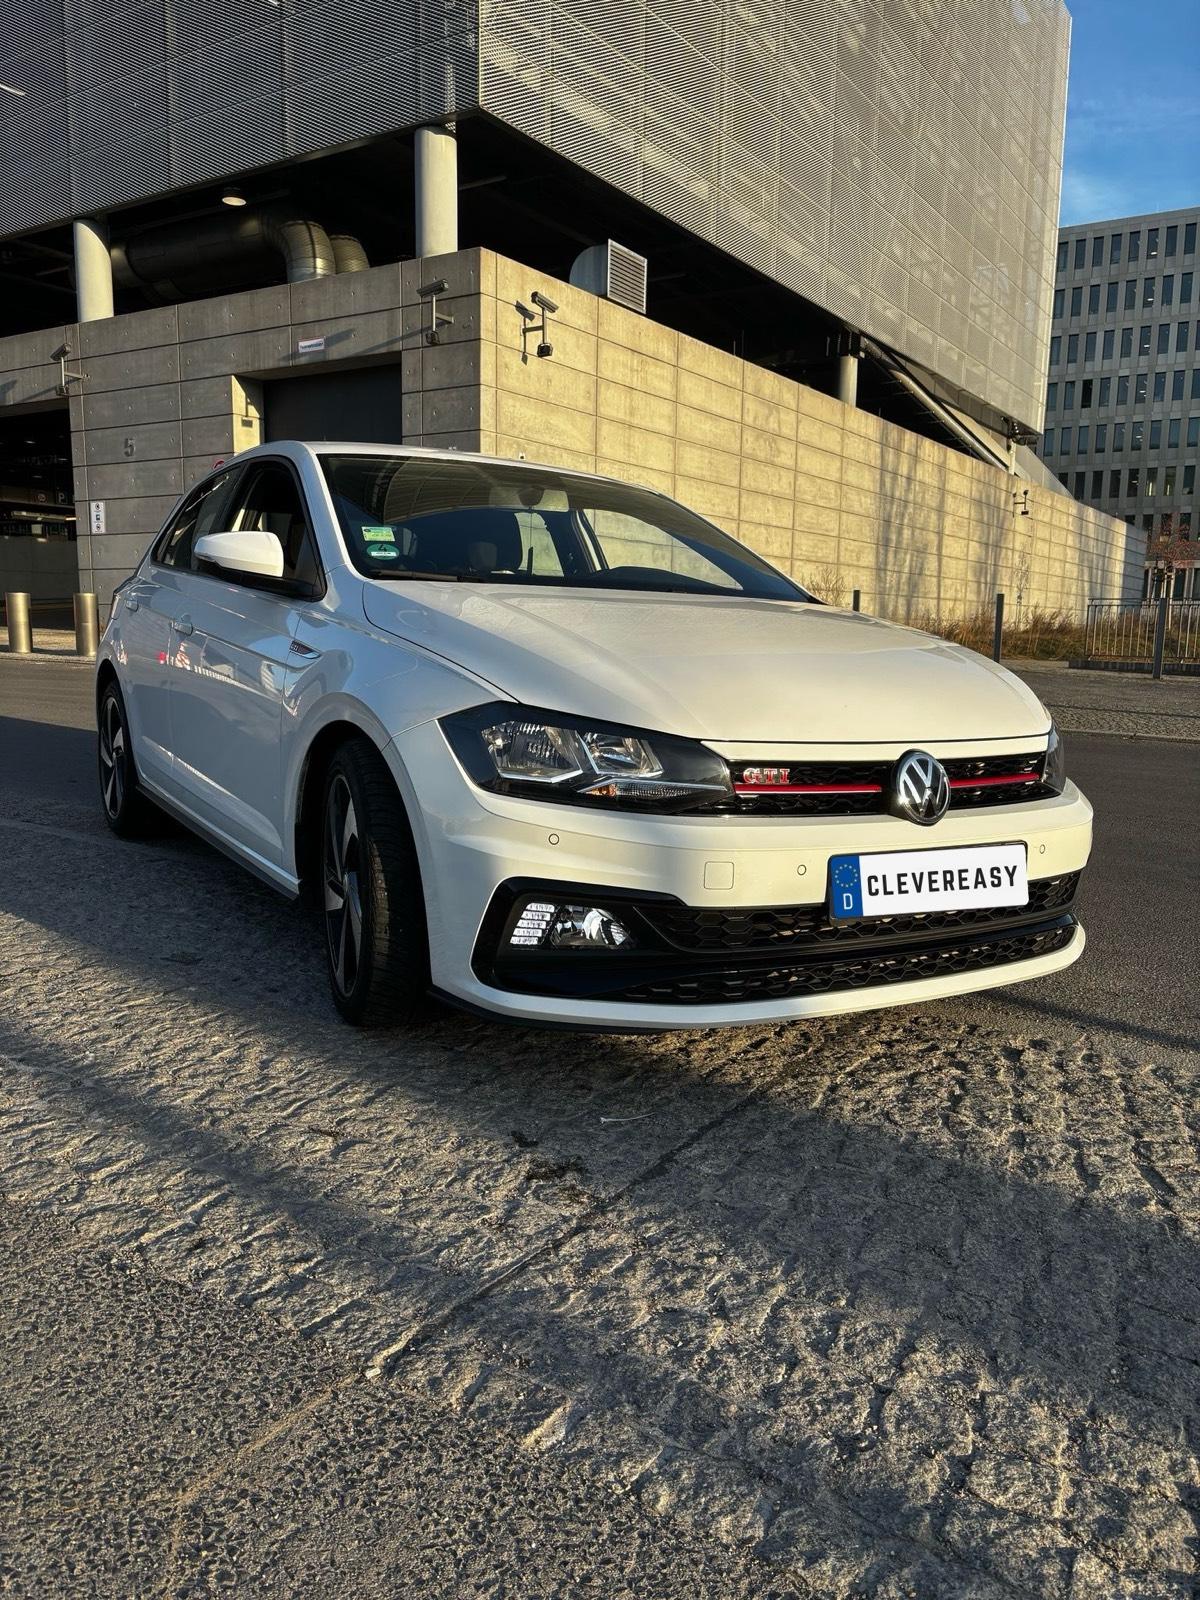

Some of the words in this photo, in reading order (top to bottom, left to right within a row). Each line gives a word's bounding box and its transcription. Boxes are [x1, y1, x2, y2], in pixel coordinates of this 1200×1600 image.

[124, 438, 135, 457] 5
[378, 544, 387, 552] 4
[743, 767, 791, 785] GTI
[866, 865, 1018, 897] CLEVEREASY
[843, 893, 853, 910] D
